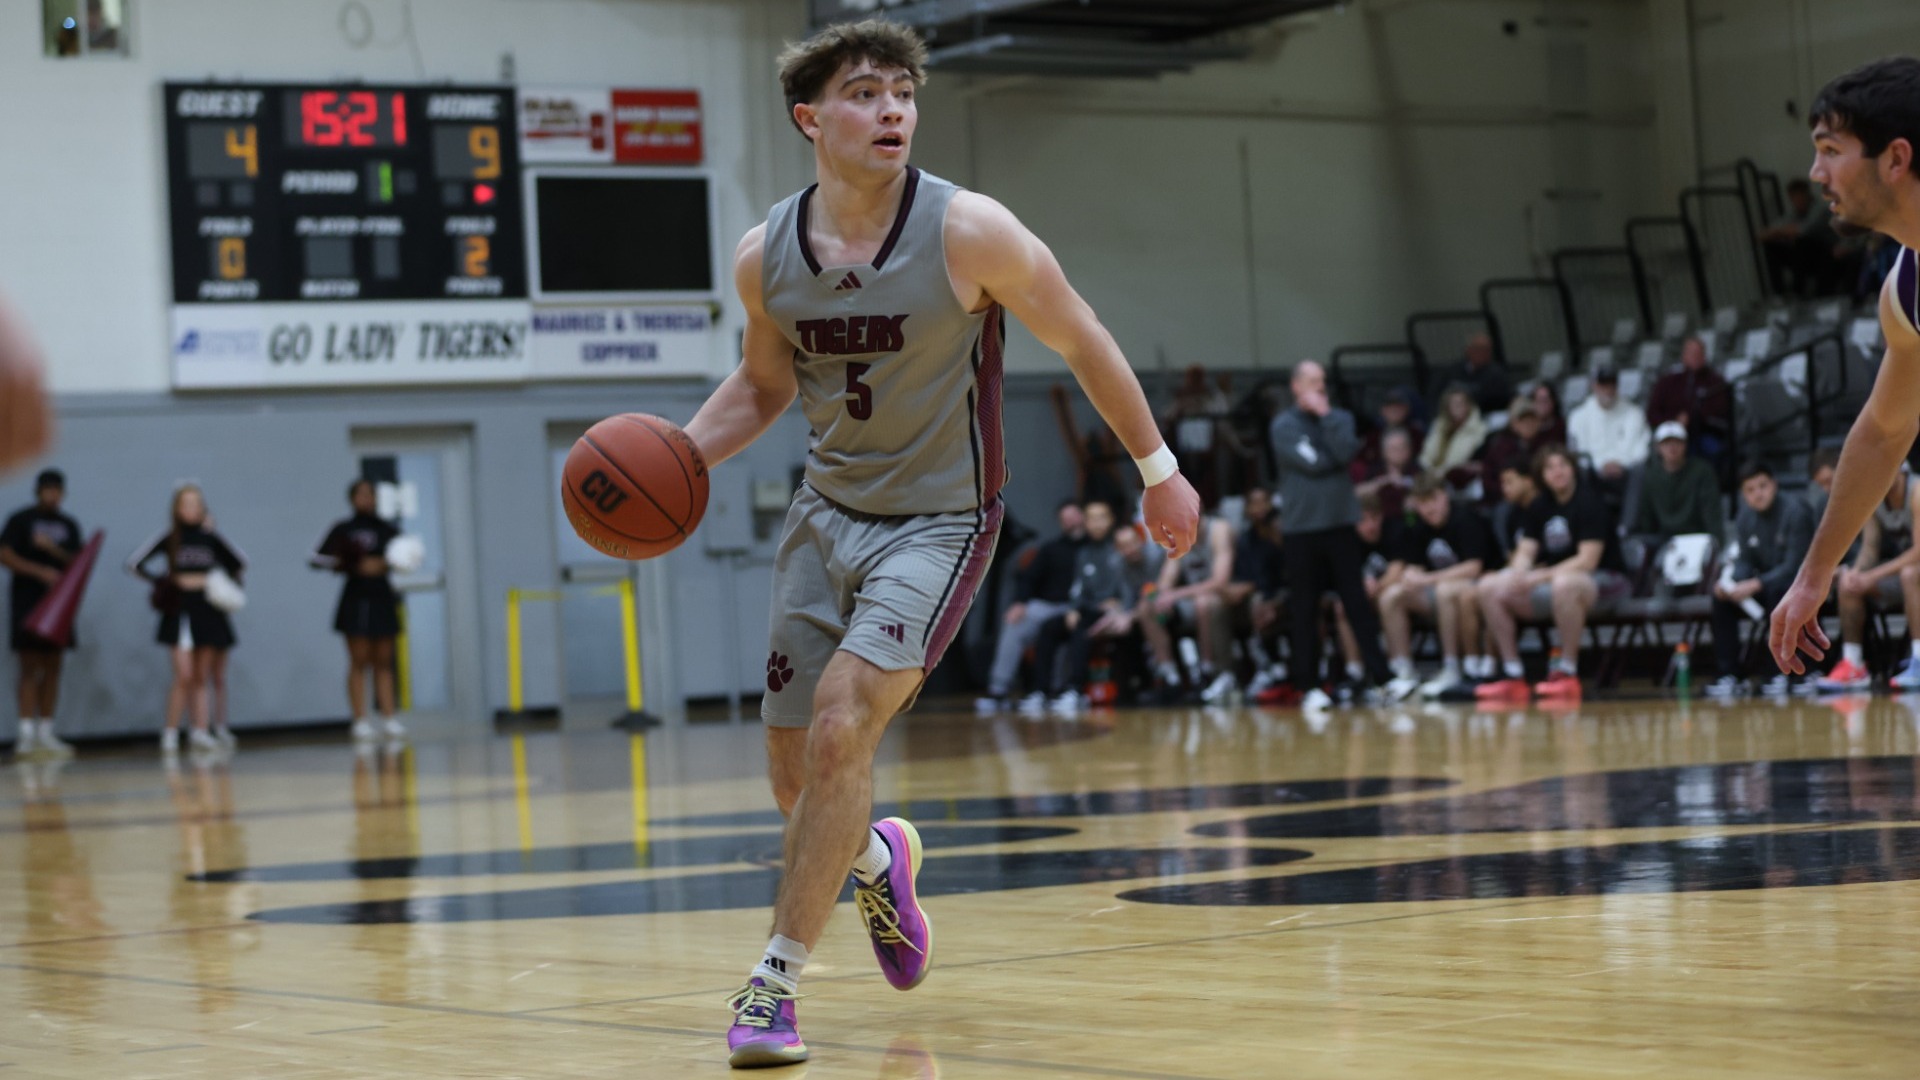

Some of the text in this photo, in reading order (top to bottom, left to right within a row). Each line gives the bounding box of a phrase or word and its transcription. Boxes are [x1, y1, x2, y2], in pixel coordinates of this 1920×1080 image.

[177, 90, 262, 116] GUEST
[301, 91, 407, 146] 15:21
[426, 94, 500, 119] HOME
[225, 124, 258, 177] 4
[469, 125, 500, 178] 9
[282, 170, 358, 193] PERIOD
[218, 237, 246, 279] 0
[464, 235, 490, 277] 2
[268, 322, 312, 365] GO
[324, 321, 403, 363] LADY
[417, 319, 527, 361] TIGERS!
[532, 310, 707, 334] MAURICE & THERESA
[796, 314, 910, 355] TIGERS
[845, 362, 872, 421] 5
[581, 469, 630, 513] CU
